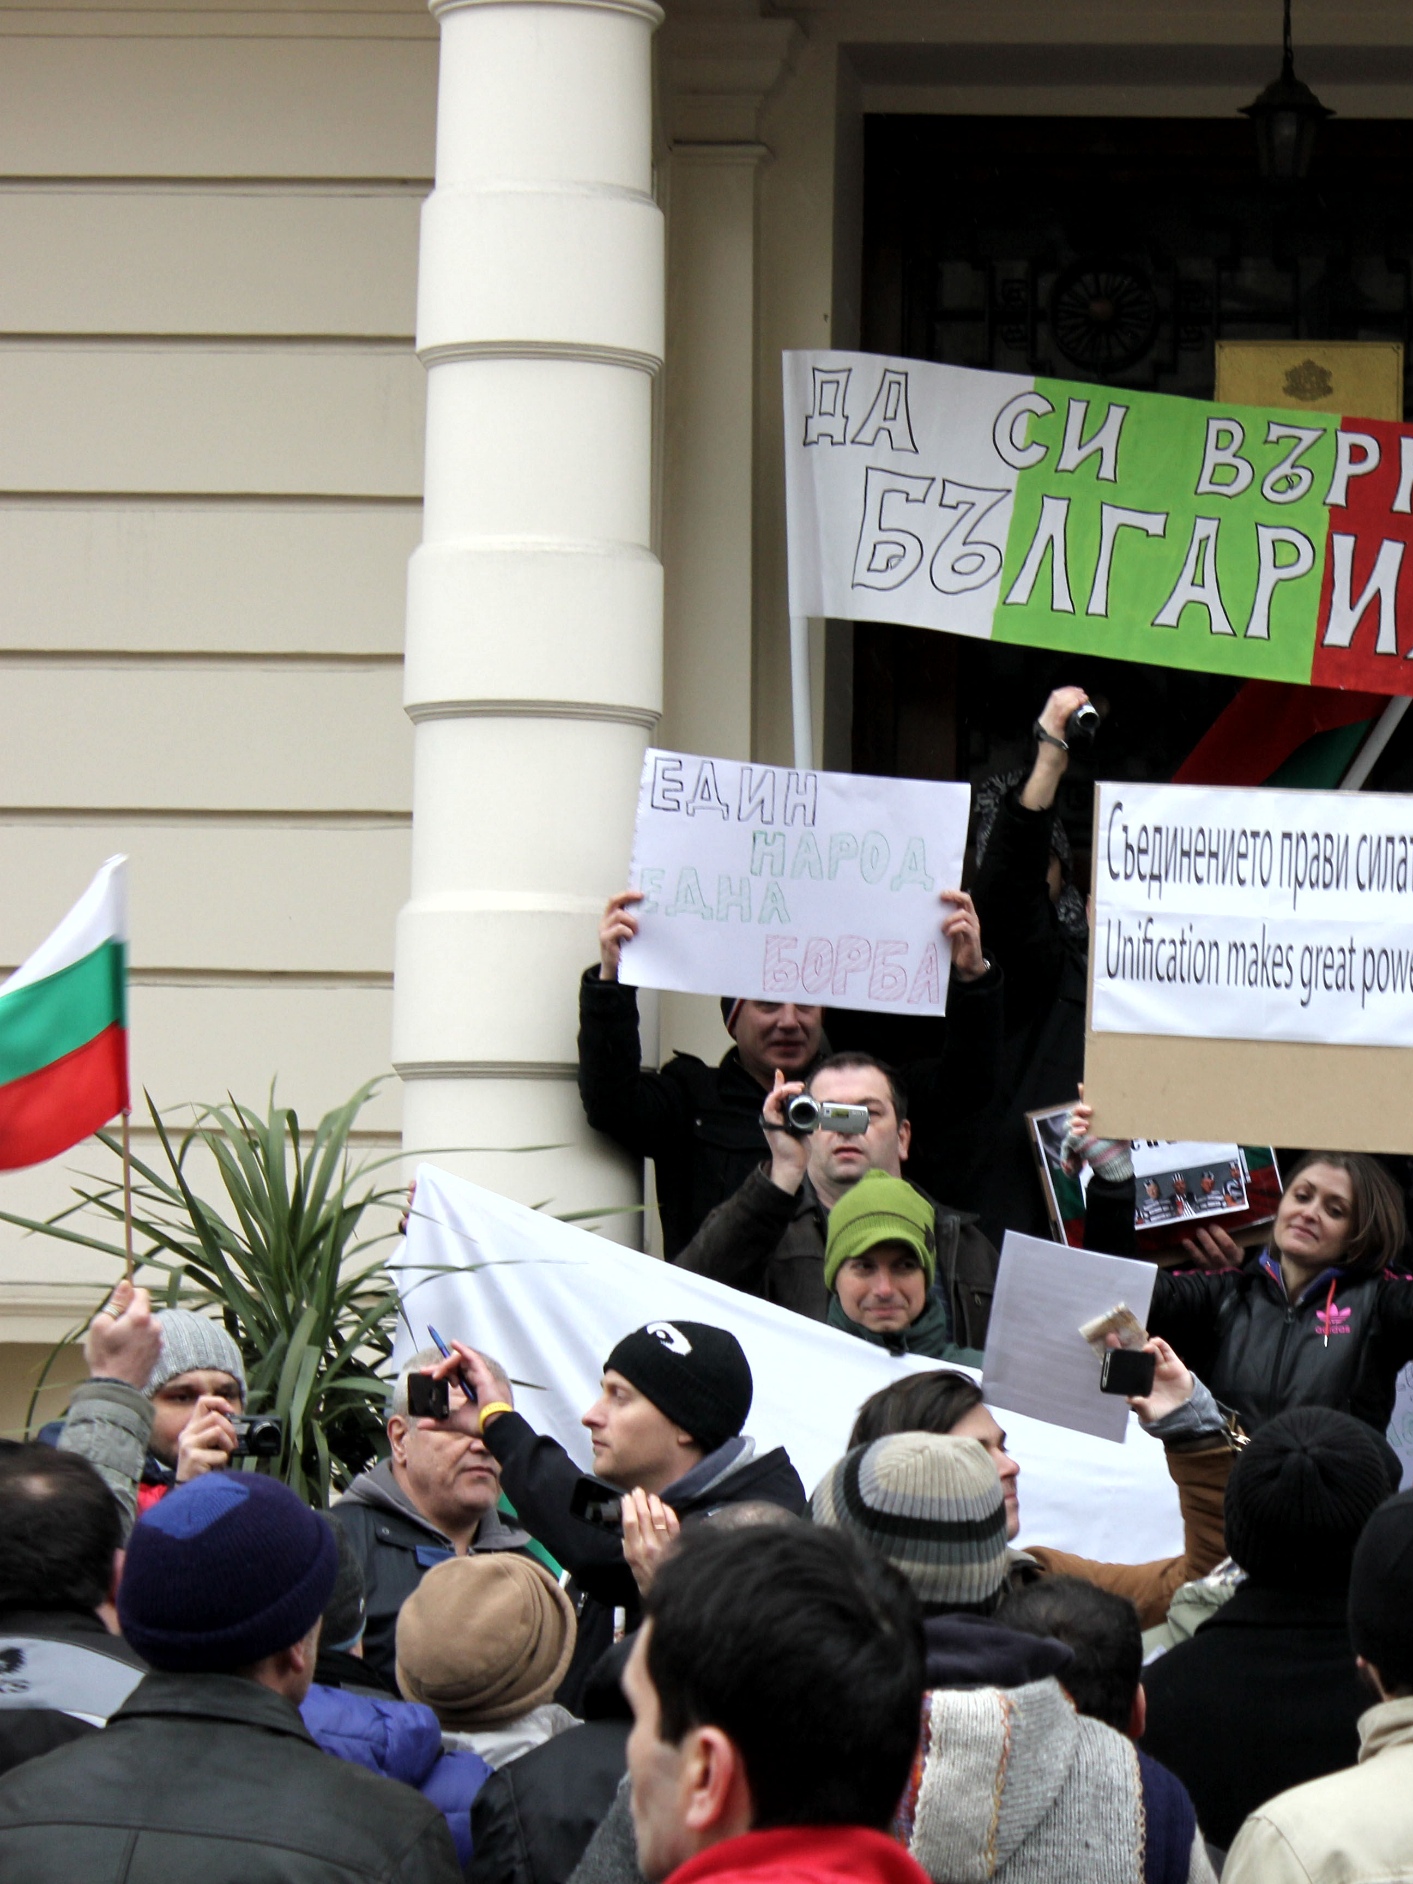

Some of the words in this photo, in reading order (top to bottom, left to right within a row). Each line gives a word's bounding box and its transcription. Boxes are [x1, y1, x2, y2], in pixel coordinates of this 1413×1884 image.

[803, 366, 918, 454] ДА
[992, 391, 1130, 482] СИ
[650, 756, 818, 828] ЕДИН
[749, 829, 935, 892] НАРОД
[1106, 801, 1274, 900] Съединението
[1278, 829, 1350, 911] прави
[637, 866, 792, 925] ЕДНА
[762, 934, 940, 1005] БОРБА
[1105, 917, 1221, 985] Unification
[1226, 923, 1294, 989] makes
[1300, 936, 1356, 1008] great
